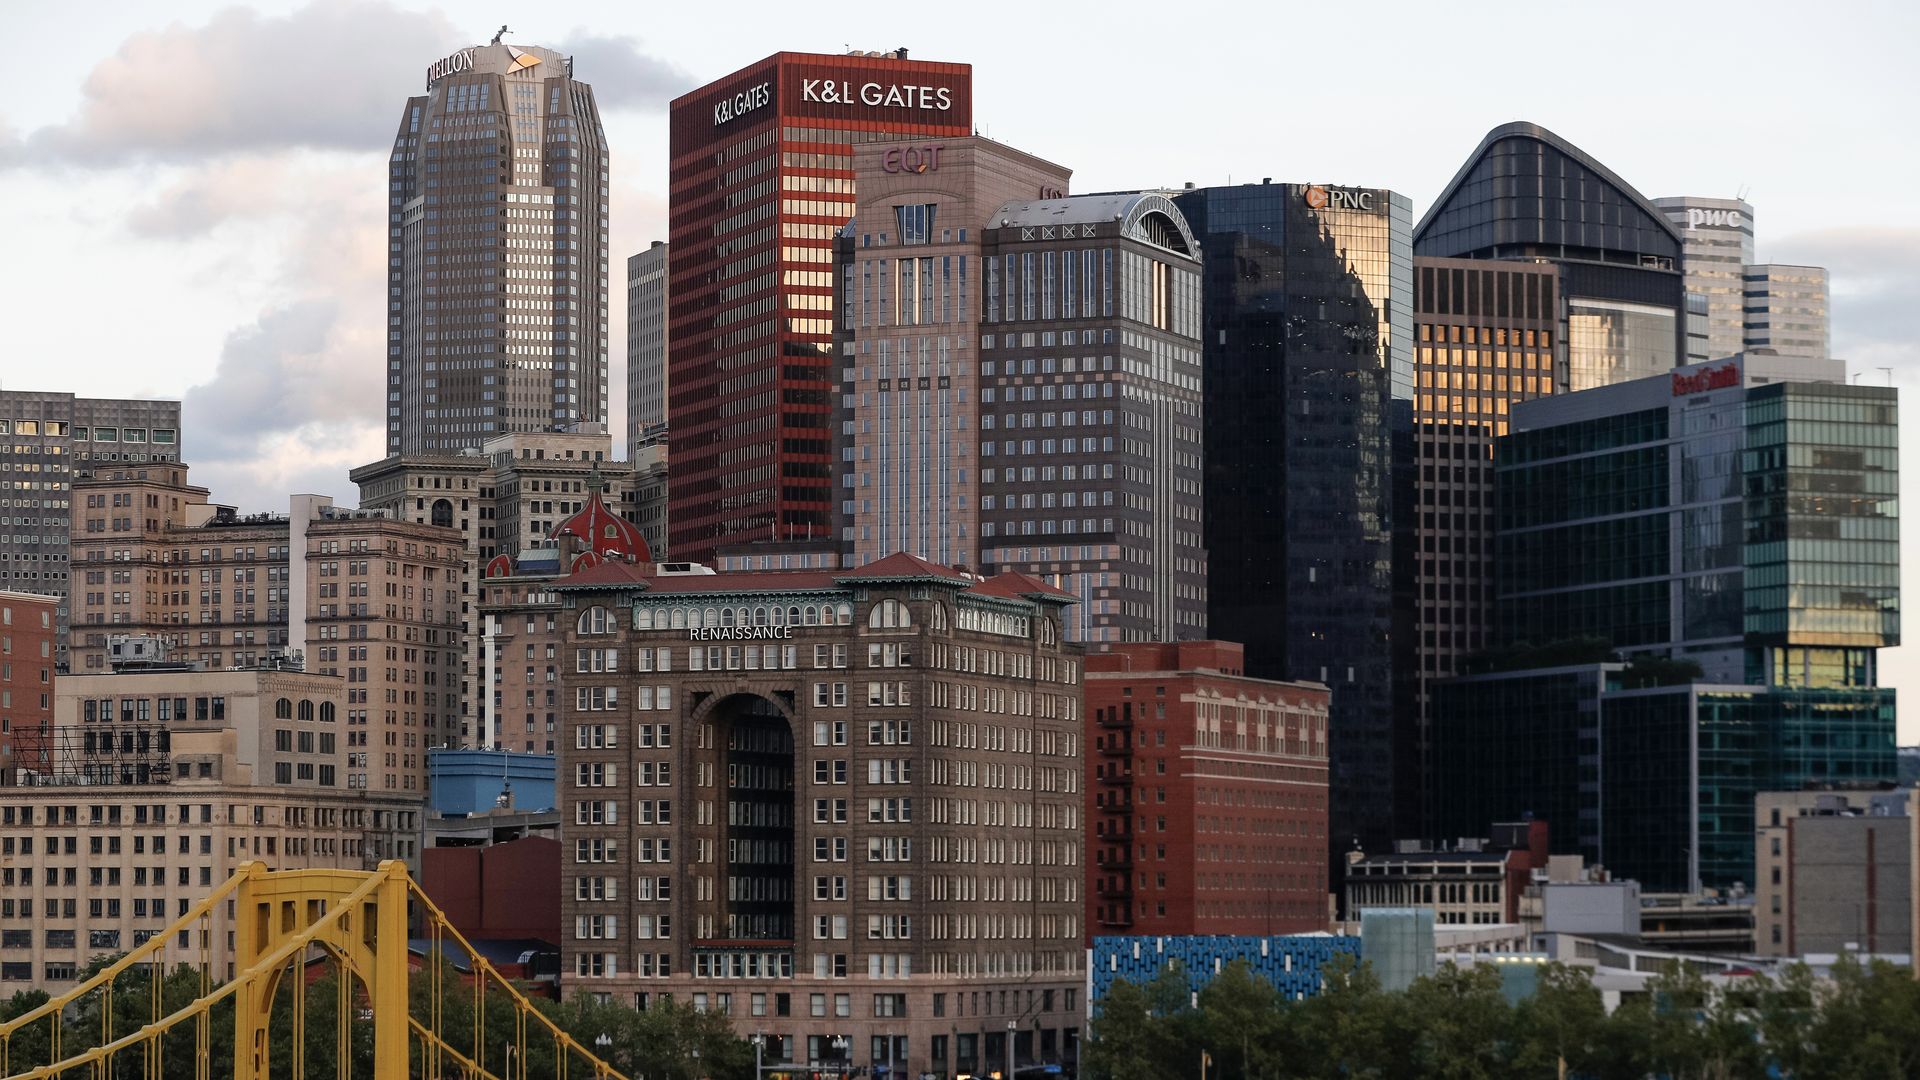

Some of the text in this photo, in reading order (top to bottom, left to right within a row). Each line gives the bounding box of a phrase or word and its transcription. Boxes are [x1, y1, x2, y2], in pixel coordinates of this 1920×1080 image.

[714, 82, 769, 126] K&L GATES
[802, 78, 951, 111] K&L GATES
[882, 143, 945, 174] EQT
[1328, 190, 1373, 210] PNC
[1687, 208, 1741, 231] pwc
[690, 626, 792, 641] RENAISSANCE
